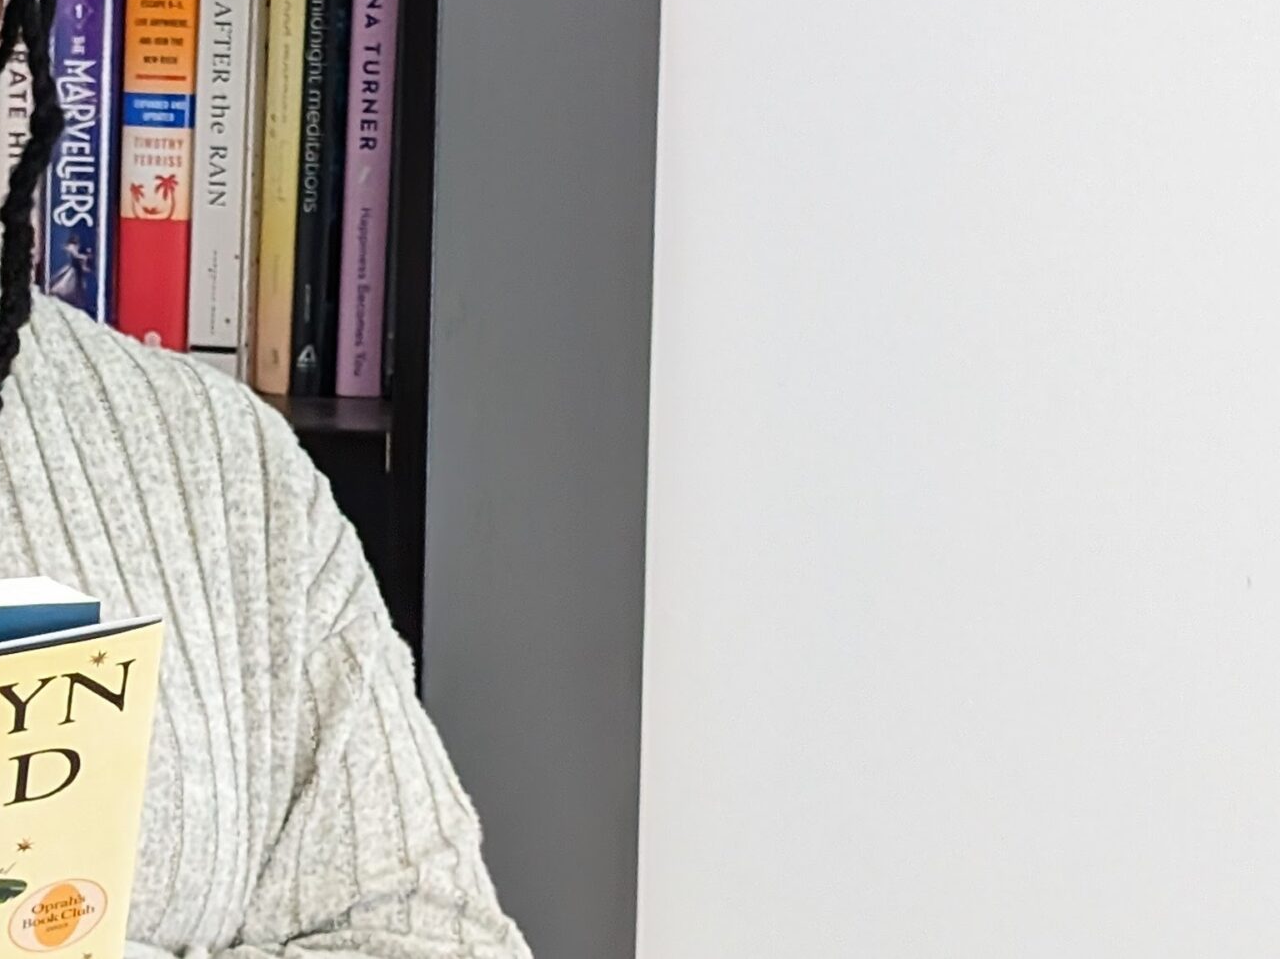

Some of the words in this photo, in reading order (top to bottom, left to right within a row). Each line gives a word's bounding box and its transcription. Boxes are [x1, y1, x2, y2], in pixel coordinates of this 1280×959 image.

[212, 1, 233, 85] AFTER
[209, 93, 232, 135] the
[357, 42, 383, 152] TURNER
[53, 58, 97, 228] MARVELLERS
[133, 136, 184, 150] TIMOTHY
[133, 154, 183, 168] FERRISS
[302, 90, 326, 214] meditations
[207, 145, 230, 208] RAIN
[356, 207, 373, 279] Happiness
[353, 283, 371, 348] Becomes
[352, 352, 368, 377] You
[22, 913, 60, 930] Book
[60, 904, 96, 921] Club
[31, 894, 86, 915] Oprah's
